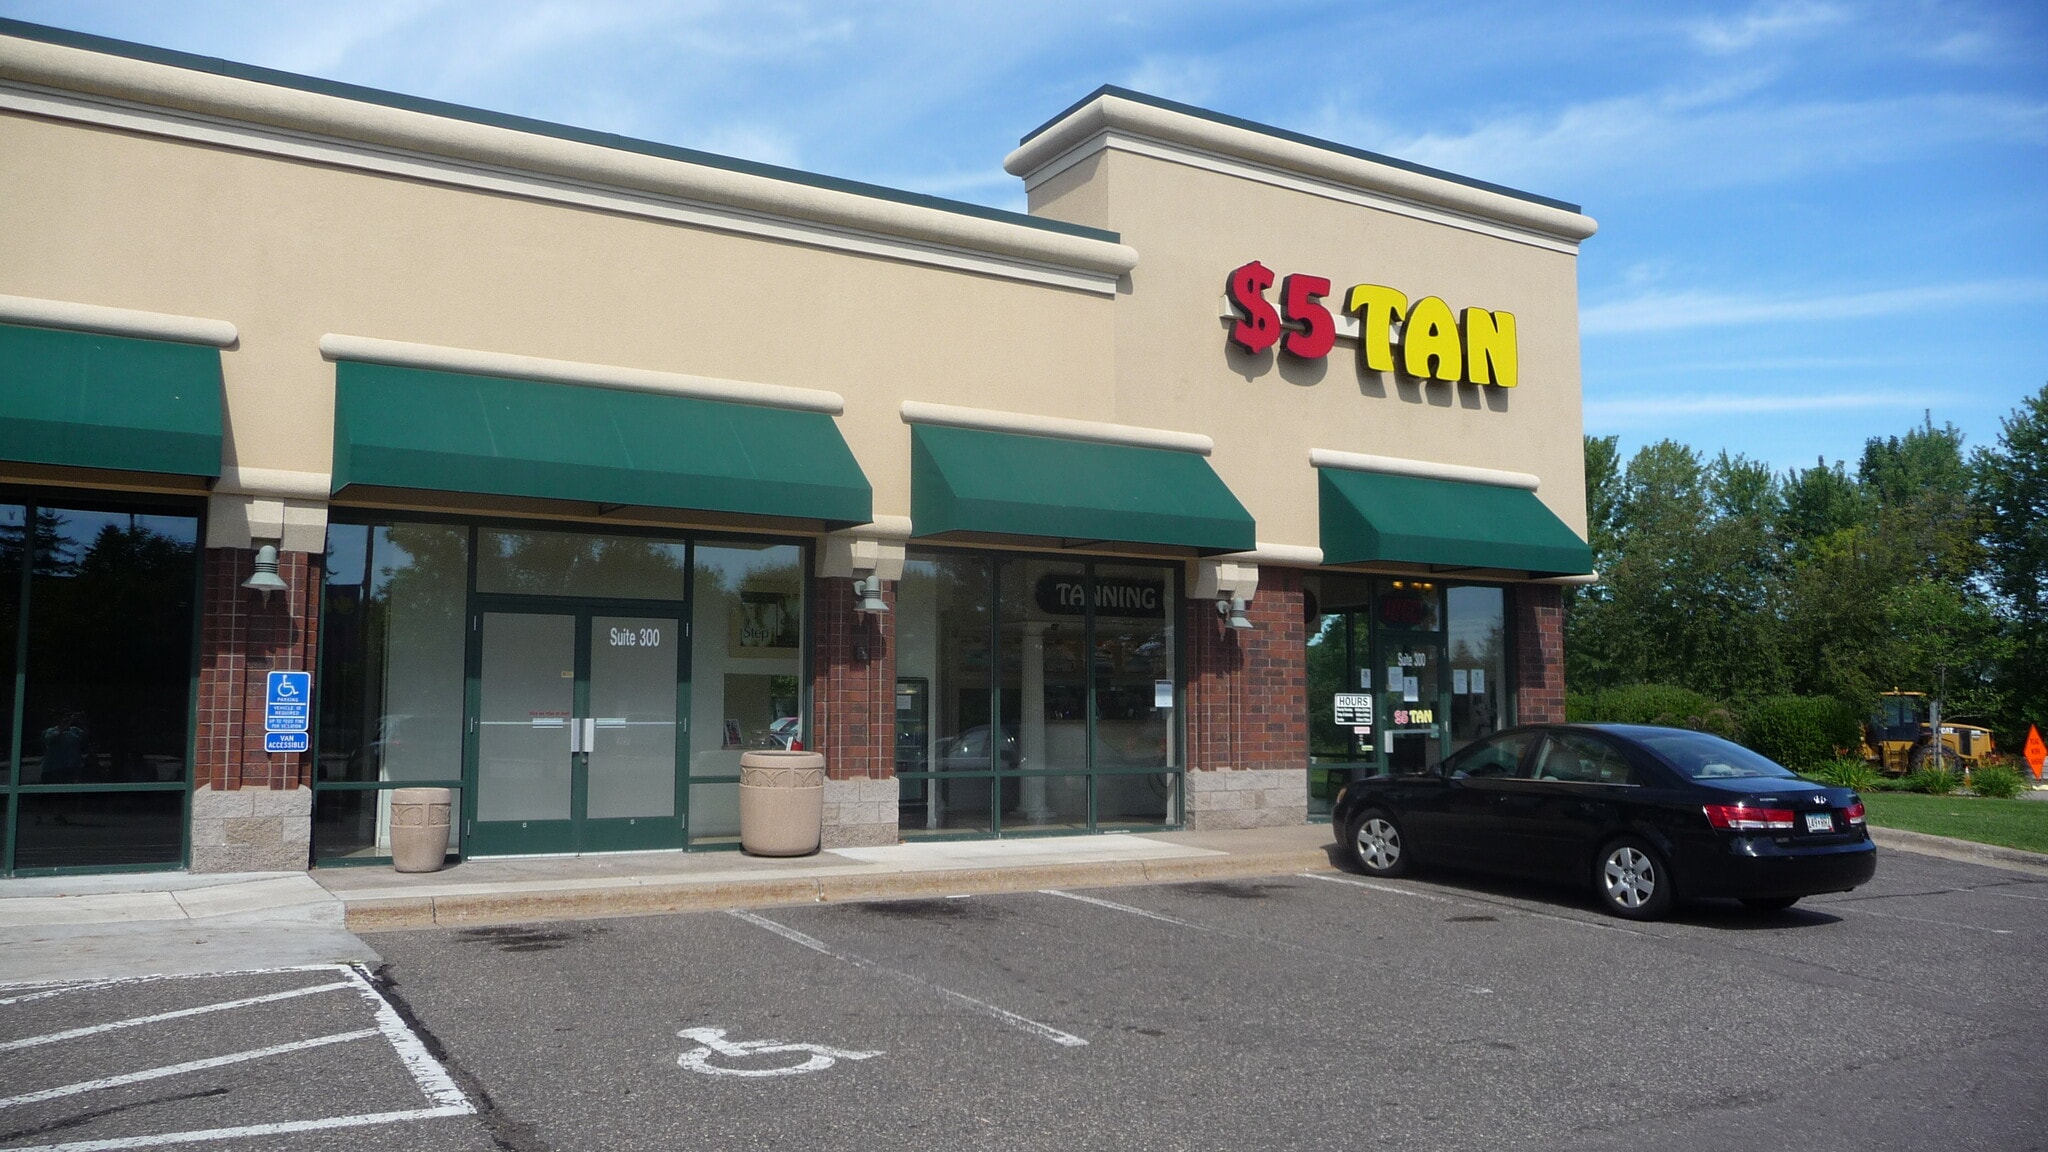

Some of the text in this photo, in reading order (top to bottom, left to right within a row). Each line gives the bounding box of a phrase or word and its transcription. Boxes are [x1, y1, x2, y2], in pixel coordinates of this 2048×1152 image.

[1227, 260, 1519, 389] $5 TAN
[610, 627, 660, 647] Suite 300
[744, 626, 769, 642] Step
[1339, 697, 1369, 707] HOURS
[1409, 709, 1433, 724] TAN
[268, 741, 305, 749] ACCESSIBLE
